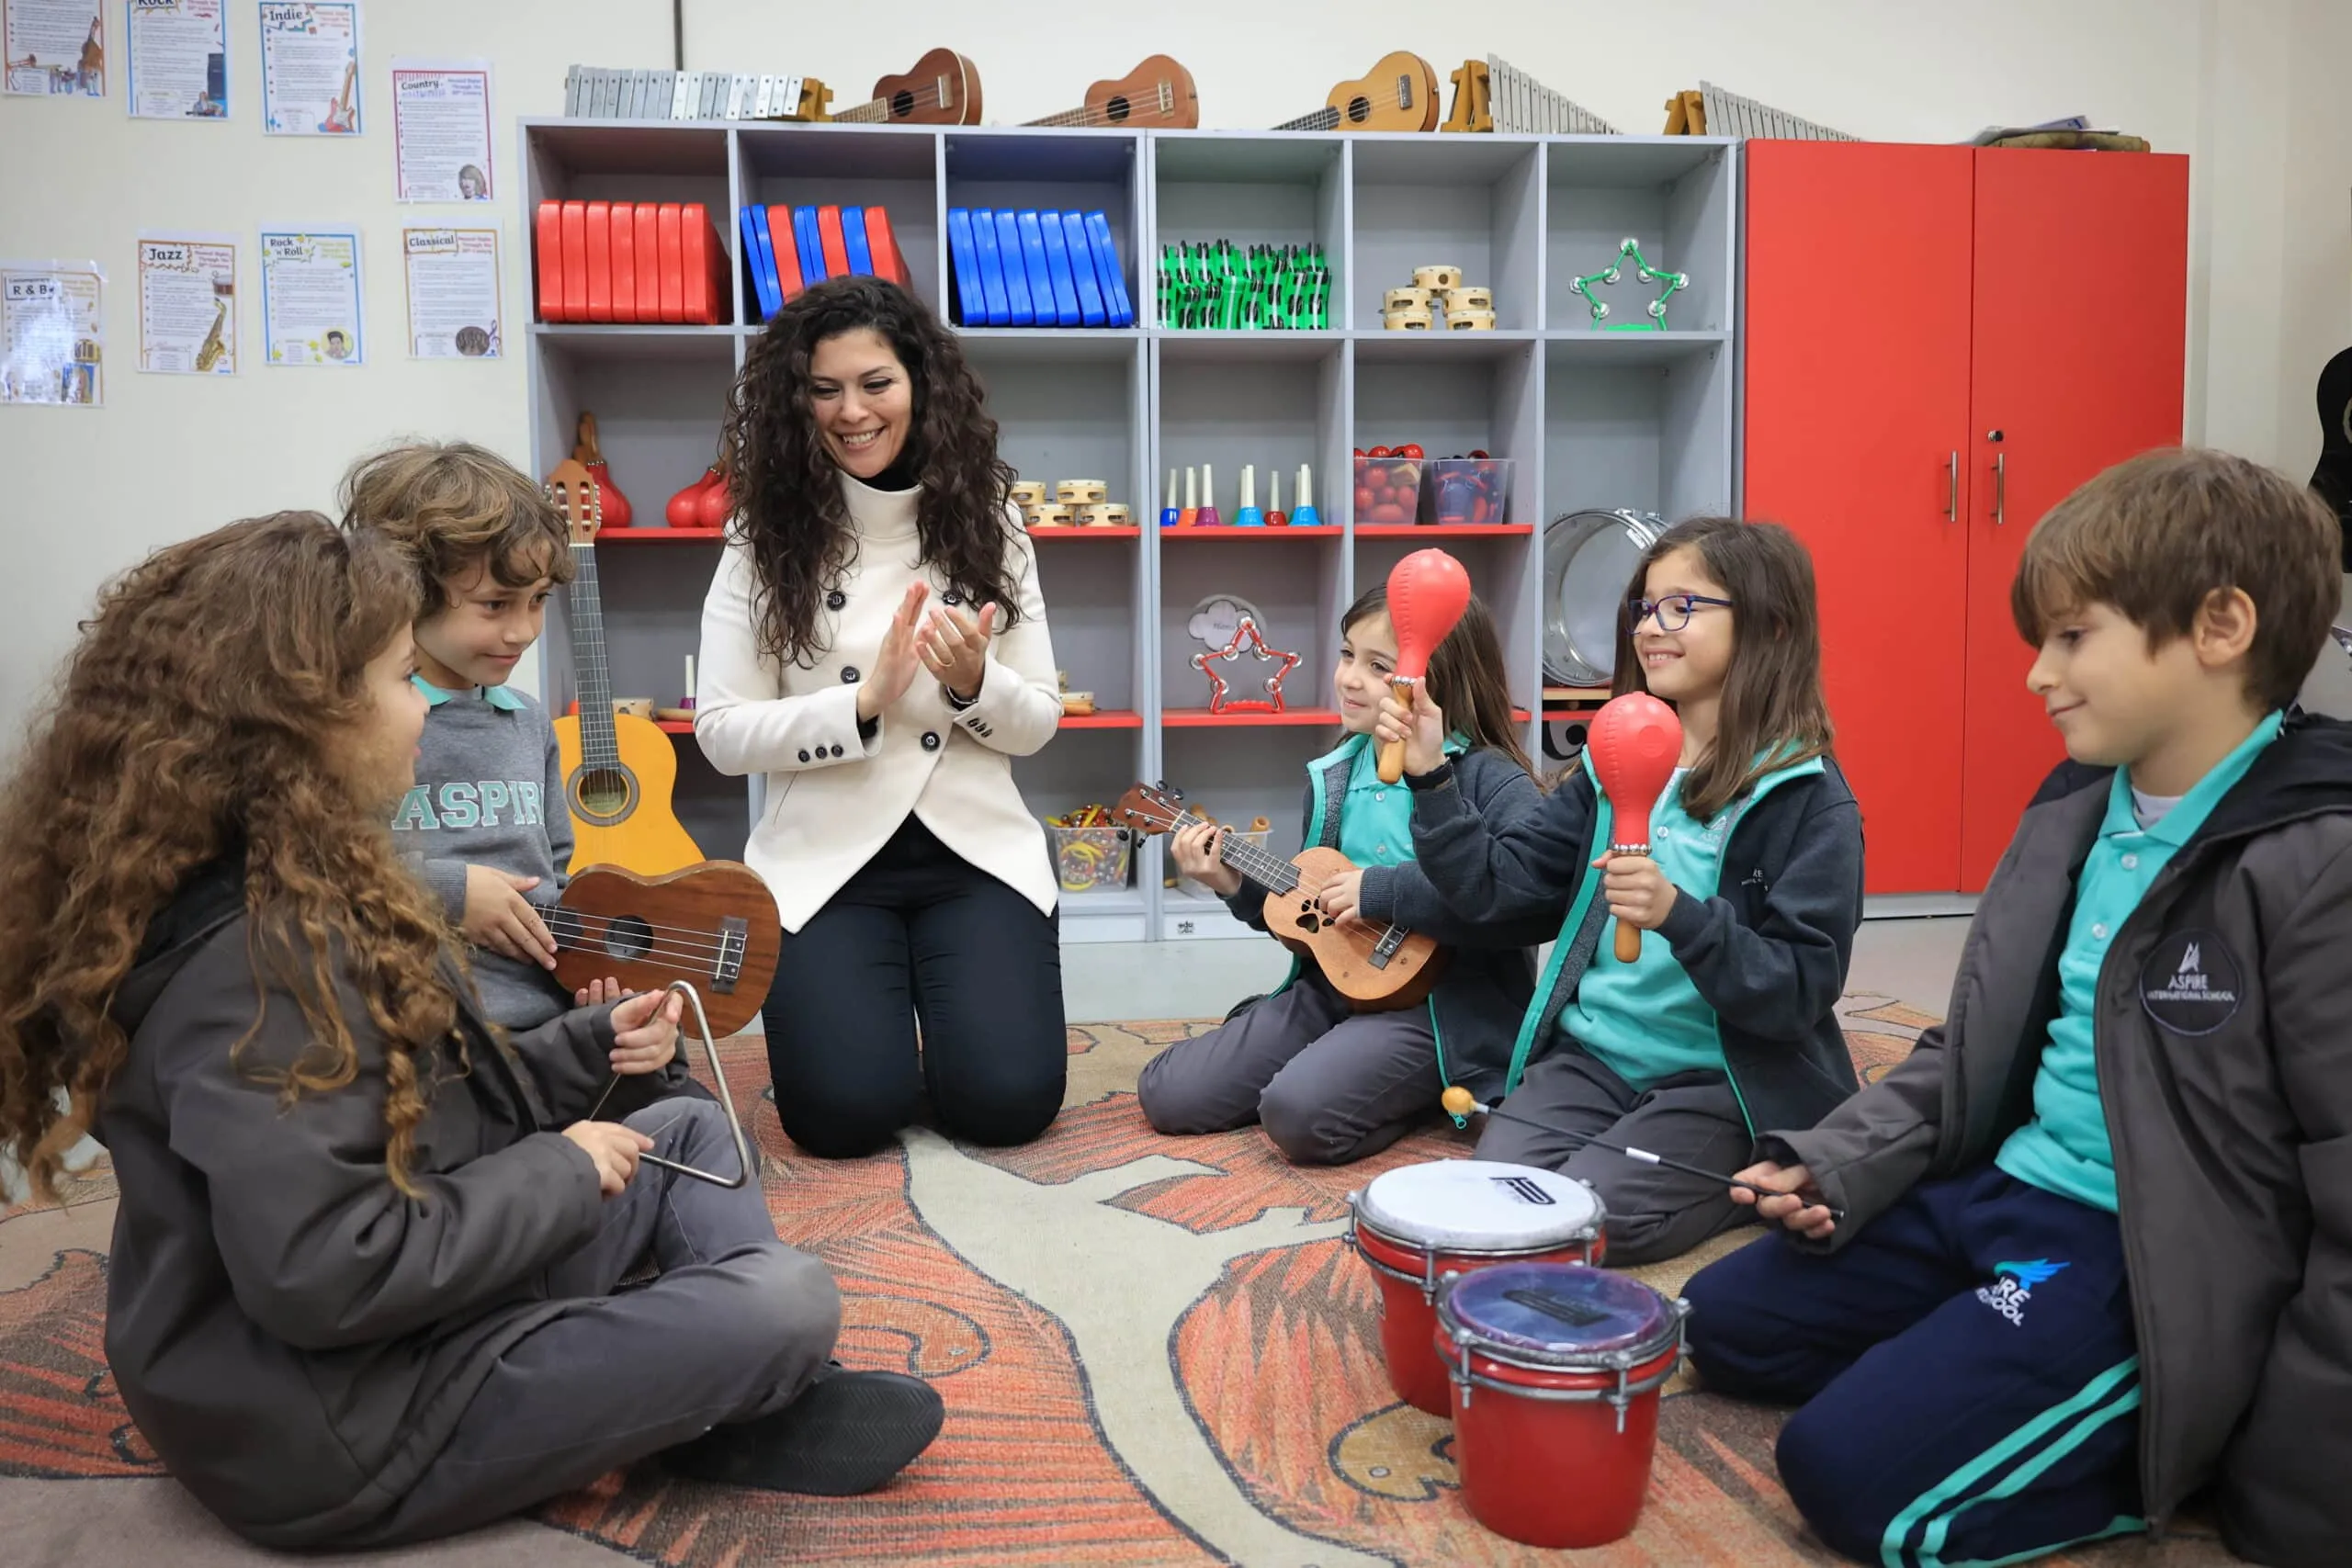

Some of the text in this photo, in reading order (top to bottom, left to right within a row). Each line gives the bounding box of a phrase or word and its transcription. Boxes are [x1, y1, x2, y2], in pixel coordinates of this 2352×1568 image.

[269, 8, 303, 21] Indie
[401, 80, 439, 90] Country
[269, 237, 293, 246] Rock
[409, 234, 455, 246] Classical
[148, 248, 183, 261] Jazz
[284, 246, 303, 256] Roll
[13, 285, 48, 295] R & B
[390, 781, 545, 830] ASPIR
[2167, 974, 2208, 990] ASPIRE
